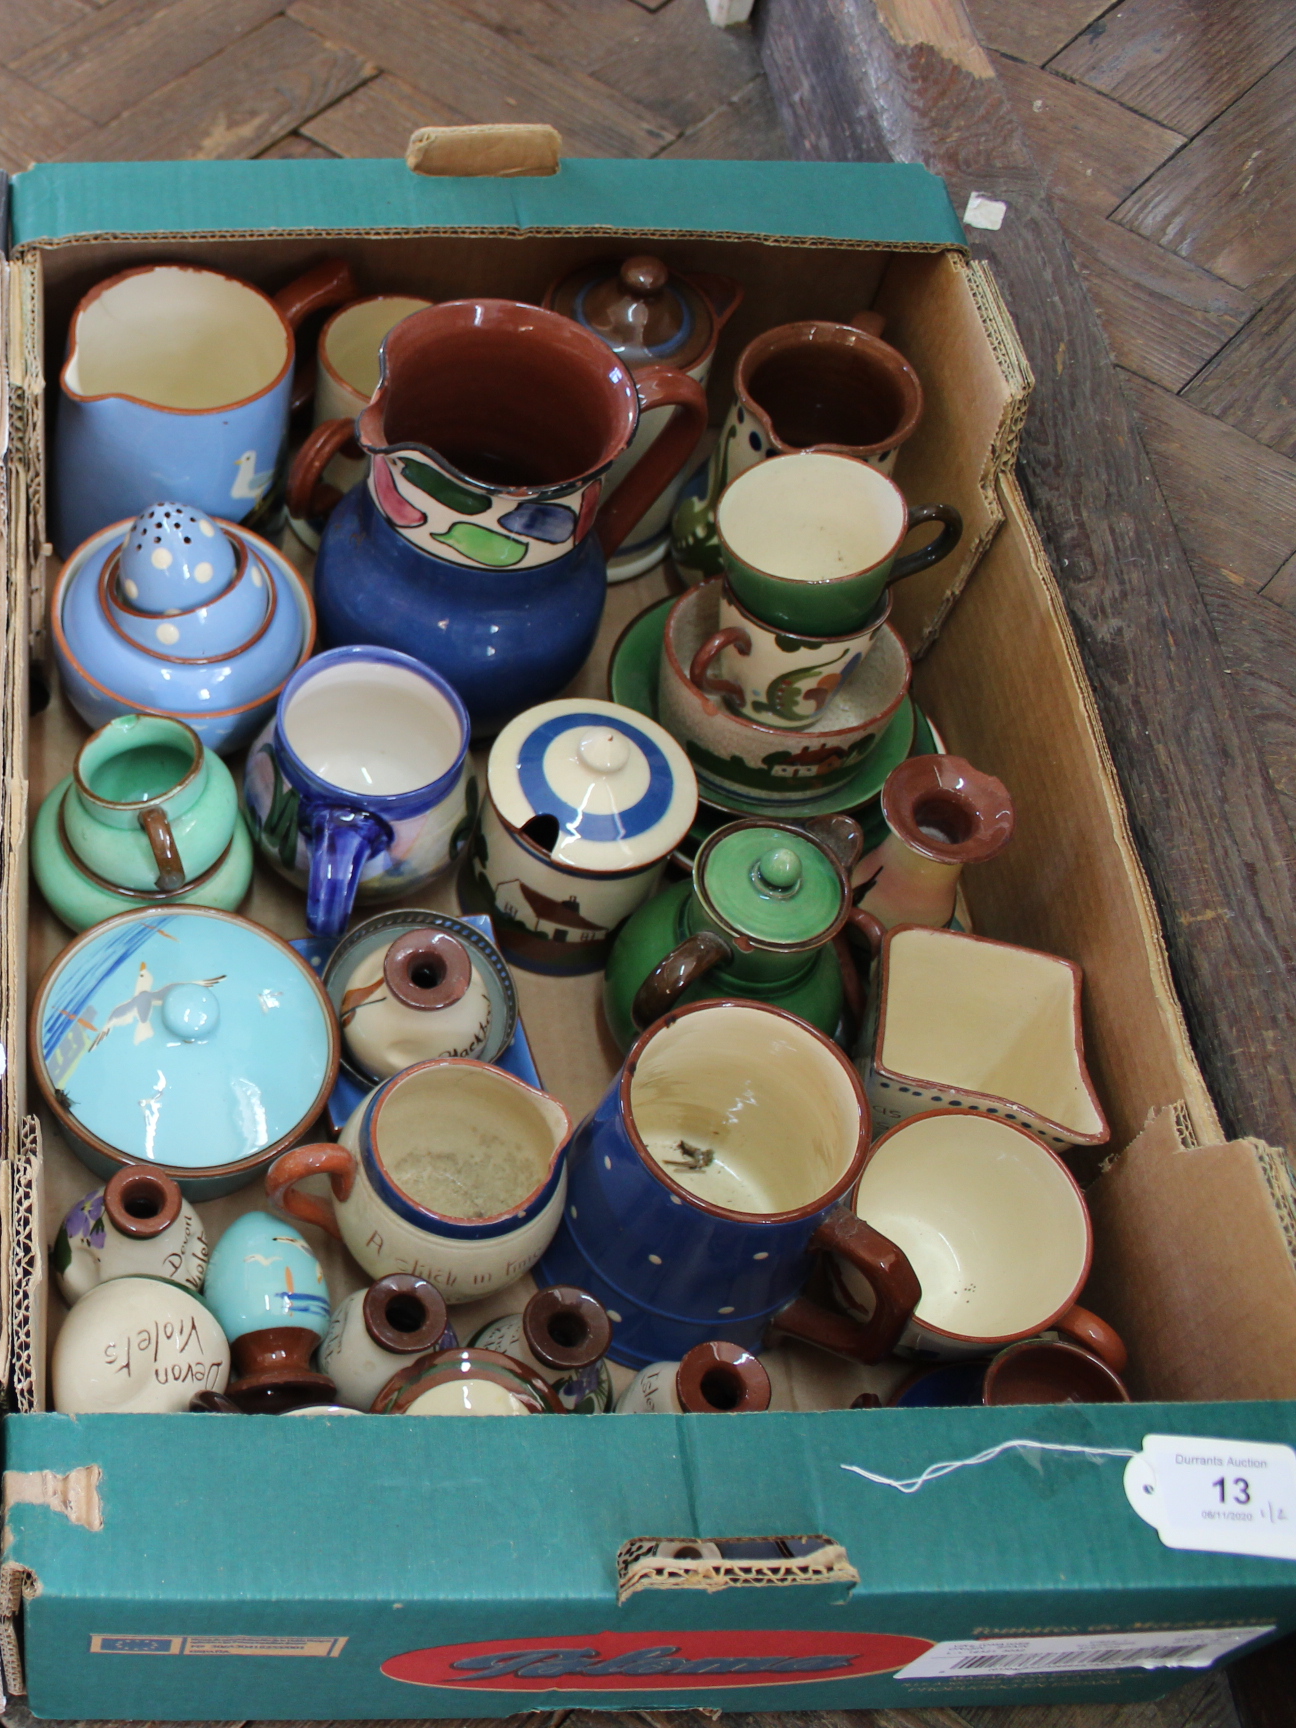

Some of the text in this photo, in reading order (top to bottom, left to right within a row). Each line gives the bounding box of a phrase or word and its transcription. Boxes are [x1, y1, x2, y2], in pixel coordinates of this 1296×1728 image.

[162, 1215, 193, 1278] Devon
[185, 1229, 210, 1289] Violet
[365, 1229, 384, 1256] A
[395, 1257, 458, 1287] stitch
[472, 1273, 492, 1286] in
[154, 1359, 224, 1391] Devon
[1175, 1453, 1267, 1469] Durrants Auction
[1211, 1475, 1251, 1505] 13
